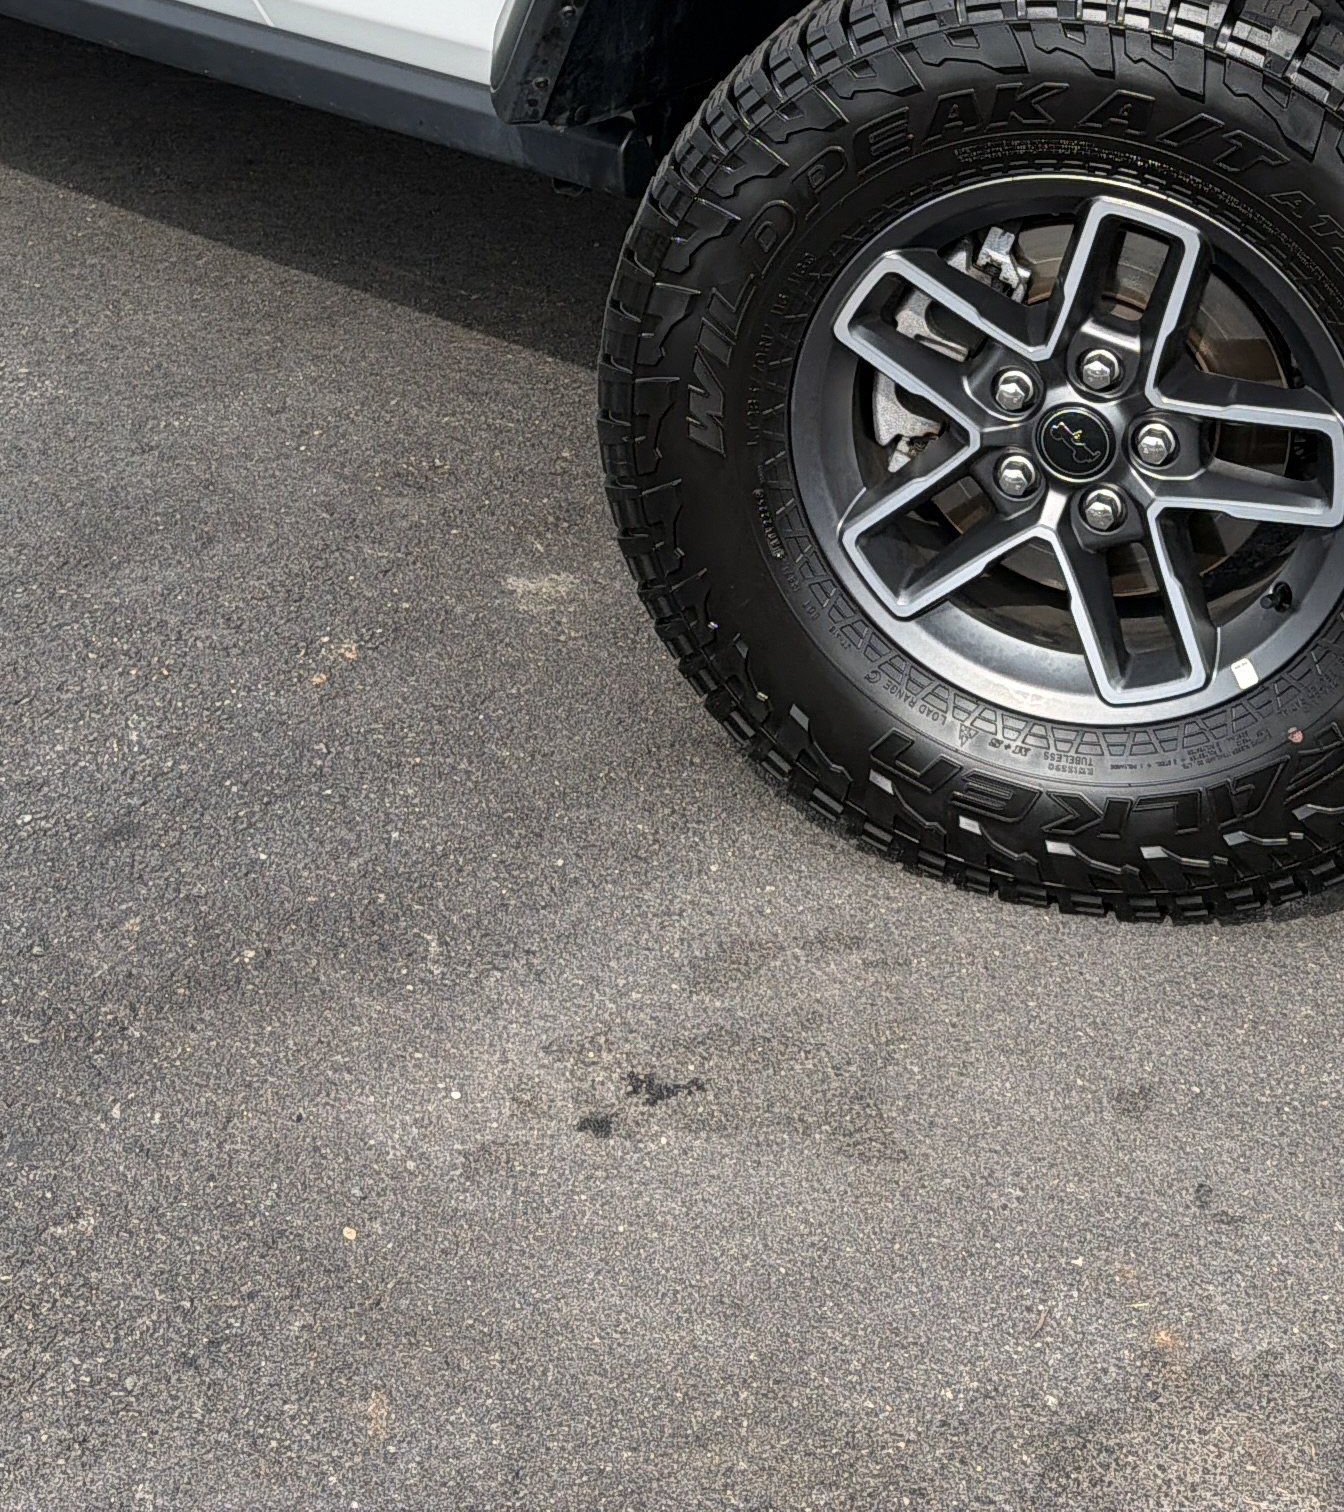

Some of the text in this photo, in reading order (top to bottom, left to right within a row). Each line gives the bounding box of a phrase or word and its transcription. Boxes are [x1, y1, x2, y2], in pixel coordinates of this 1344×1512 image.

[685, 81, 1071, 455] WILDPEAK
[882, 679, 916, 710] RANGE
[918, 701, 948, 727] LOAD
[1042, 750, 1094, 768] TUBELESS
